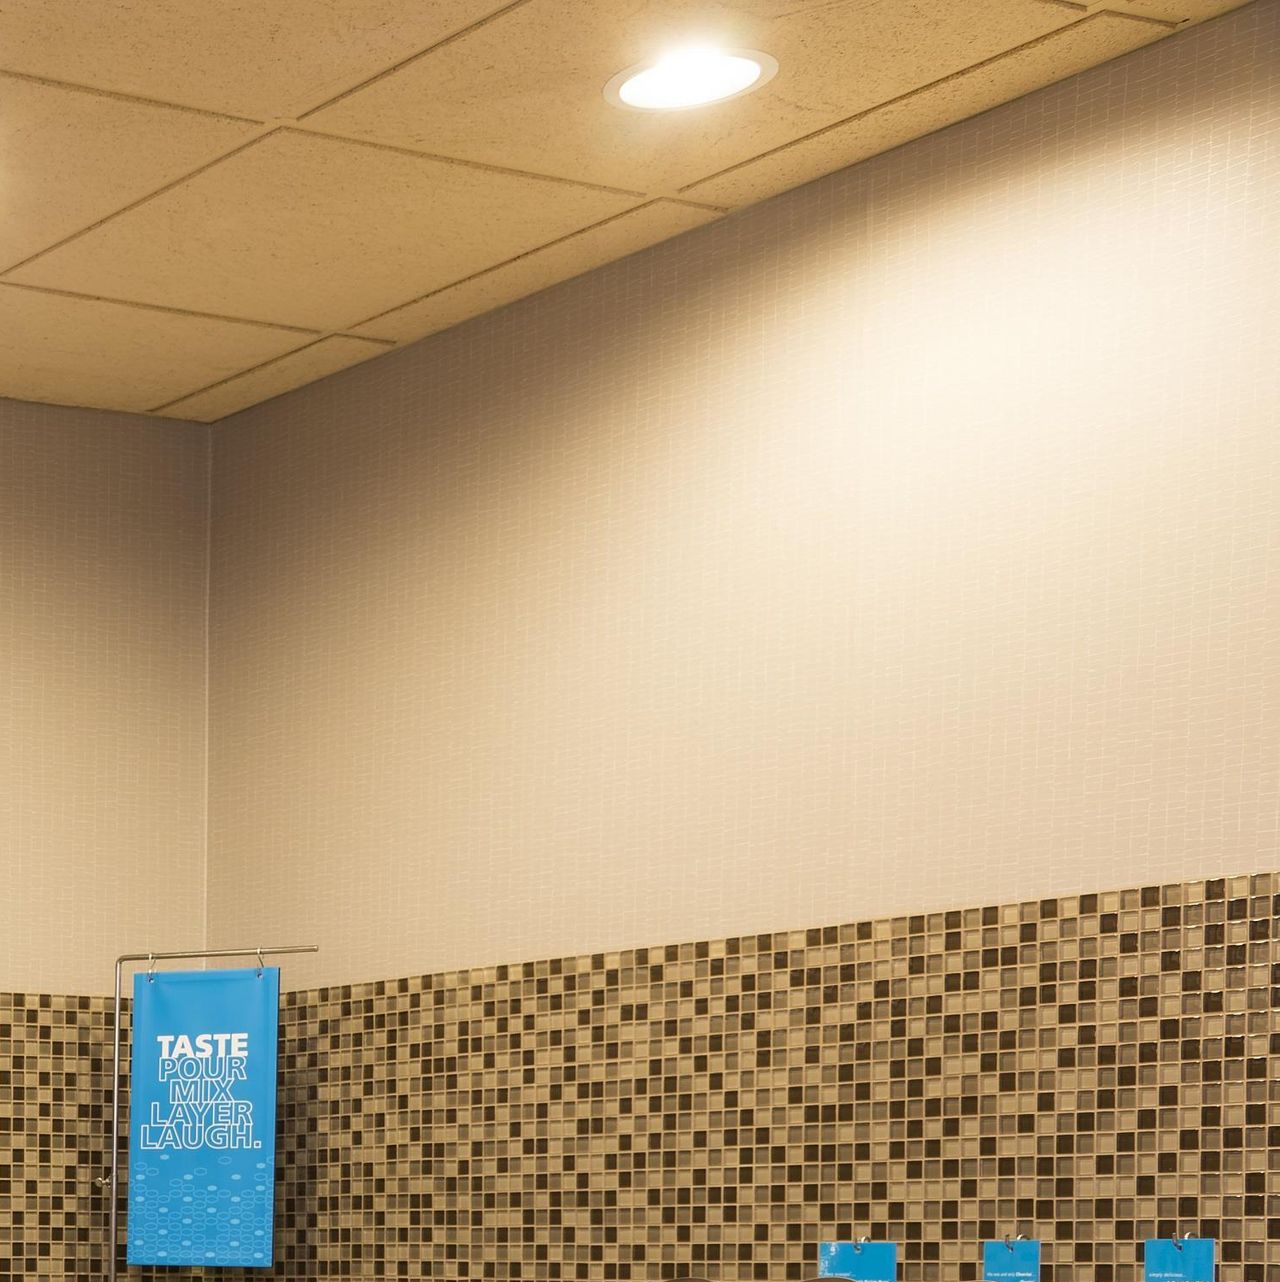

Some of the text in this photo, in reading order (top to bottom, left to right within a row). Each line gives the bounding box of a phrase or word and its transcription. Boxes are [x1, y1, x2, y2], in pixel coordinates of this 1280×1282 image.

[156, 1033, 248, 1058] TASTE
[158, 1056, 248, 1082] POUR
[169, 1078, 235, 1104] MIX
[150, 1101, 253, 1127] LAYER
[140, 1125, 262, 1150] LAUGH.
